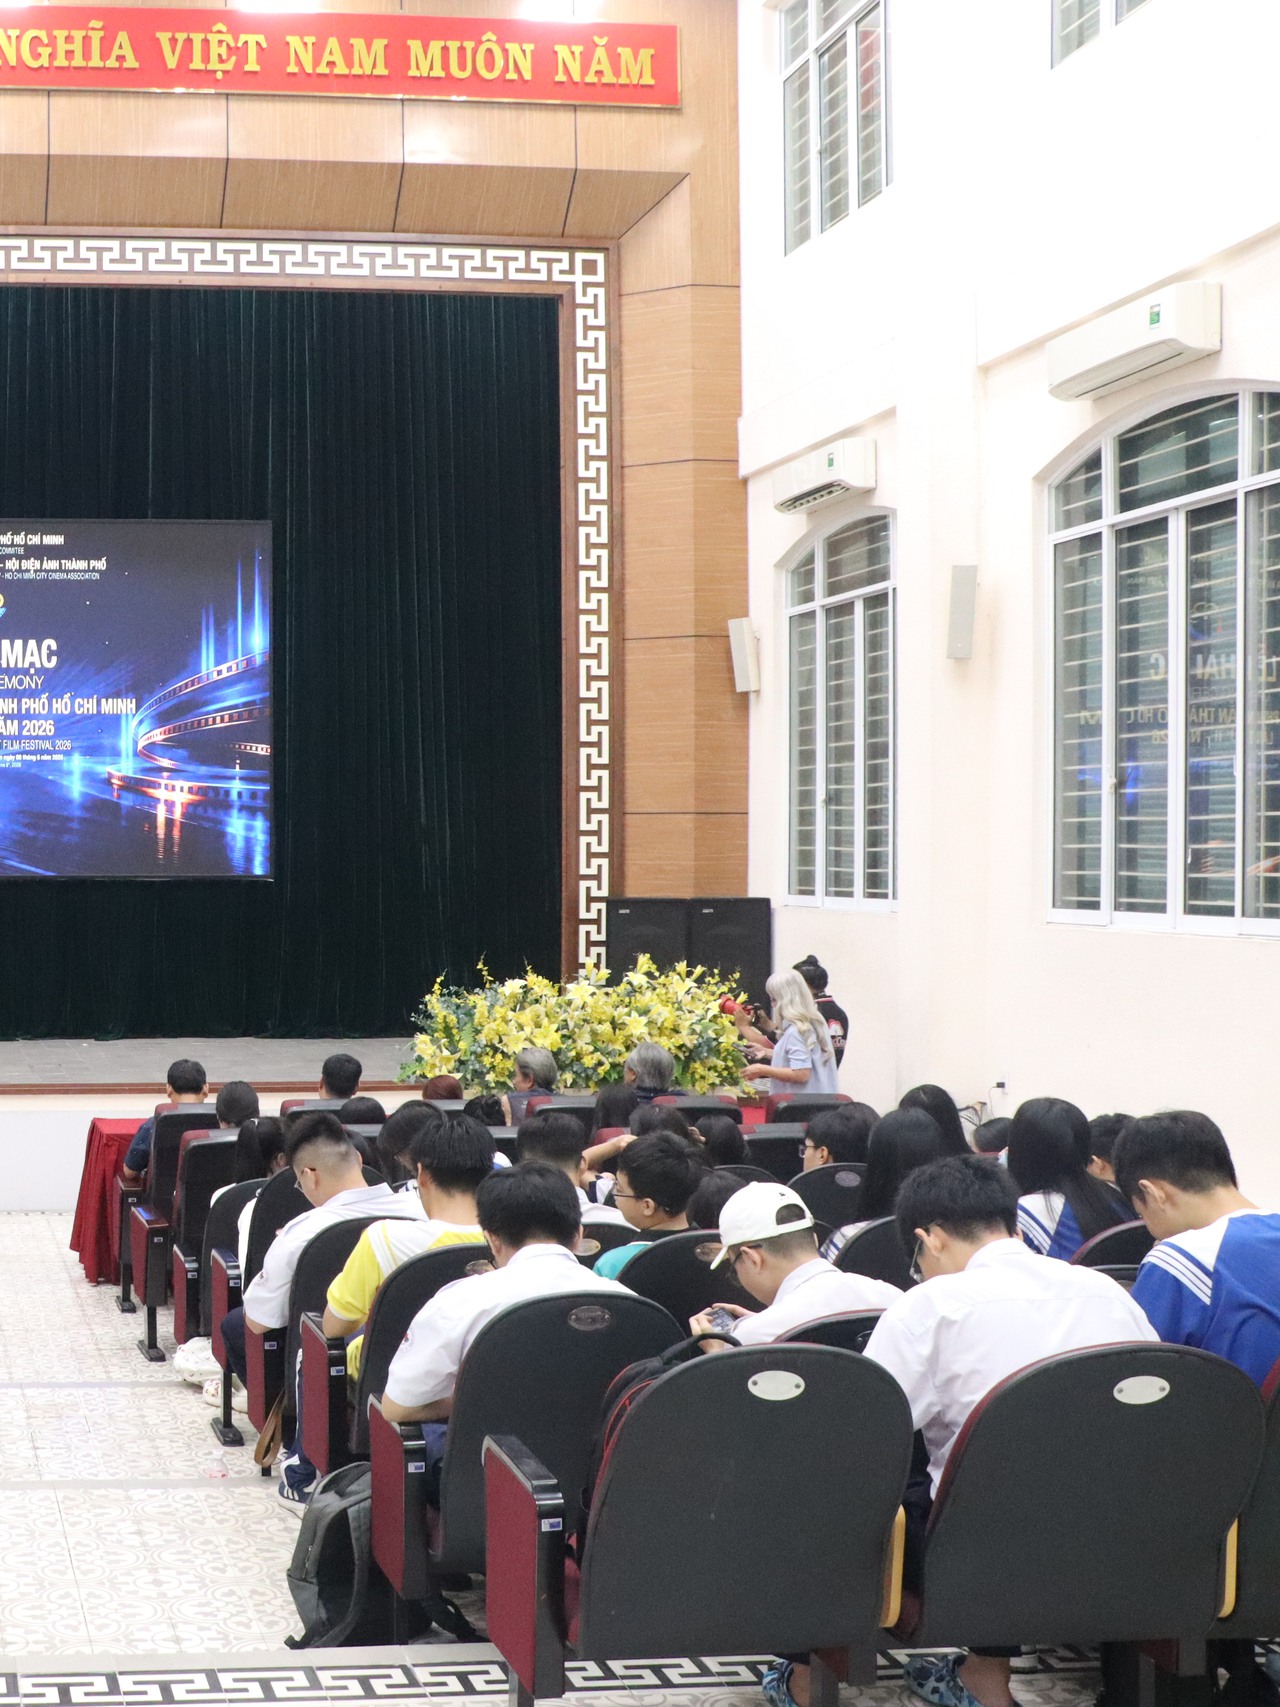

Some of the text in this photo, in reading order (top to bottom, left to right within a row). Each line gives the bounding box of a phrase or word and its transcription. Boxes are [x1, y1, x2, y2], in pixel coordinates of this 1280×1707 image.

[155, 23, 267, 79] VIỆT
[286, 35, 389, 76] NAM
[407, 31, 534, 82] MUÔN
[554, 36, 656, 86] NĂM
[27, 532, 41, 545] CHÍ
[42, 534, 64, 545] MINH
[6, 557, 19, 572] HỘI
[21, 557, 40, 574] ĐIỆN
[42, 556, 59, 570] ẢNH
[61, 557, 88, 570] THÀNH
[90, 556, 107, 570] PHỐ
[5, 572, 13, 580] HO
[14, 572, 22, 580] CHI
[36, 572, 48, 580] CITY
[49, 572, 67, 580] CINEMA
[67, 572, 100, 580] ASSOCIATION
[1, 638, 58, 674] MẠC
[21, 692, 49, 715] PHỐ
[52, 692, 71, 715] HỒ
[74, 695, 98, 715] CHÍ
[101, 698, 136, 715] MINH
[22, 719, 55, 736] 2026
[4, 740, 19, 750] FILM
[21, 740, 54, 750] FESTIVAL
[56, 740, 72, 750] 2026
